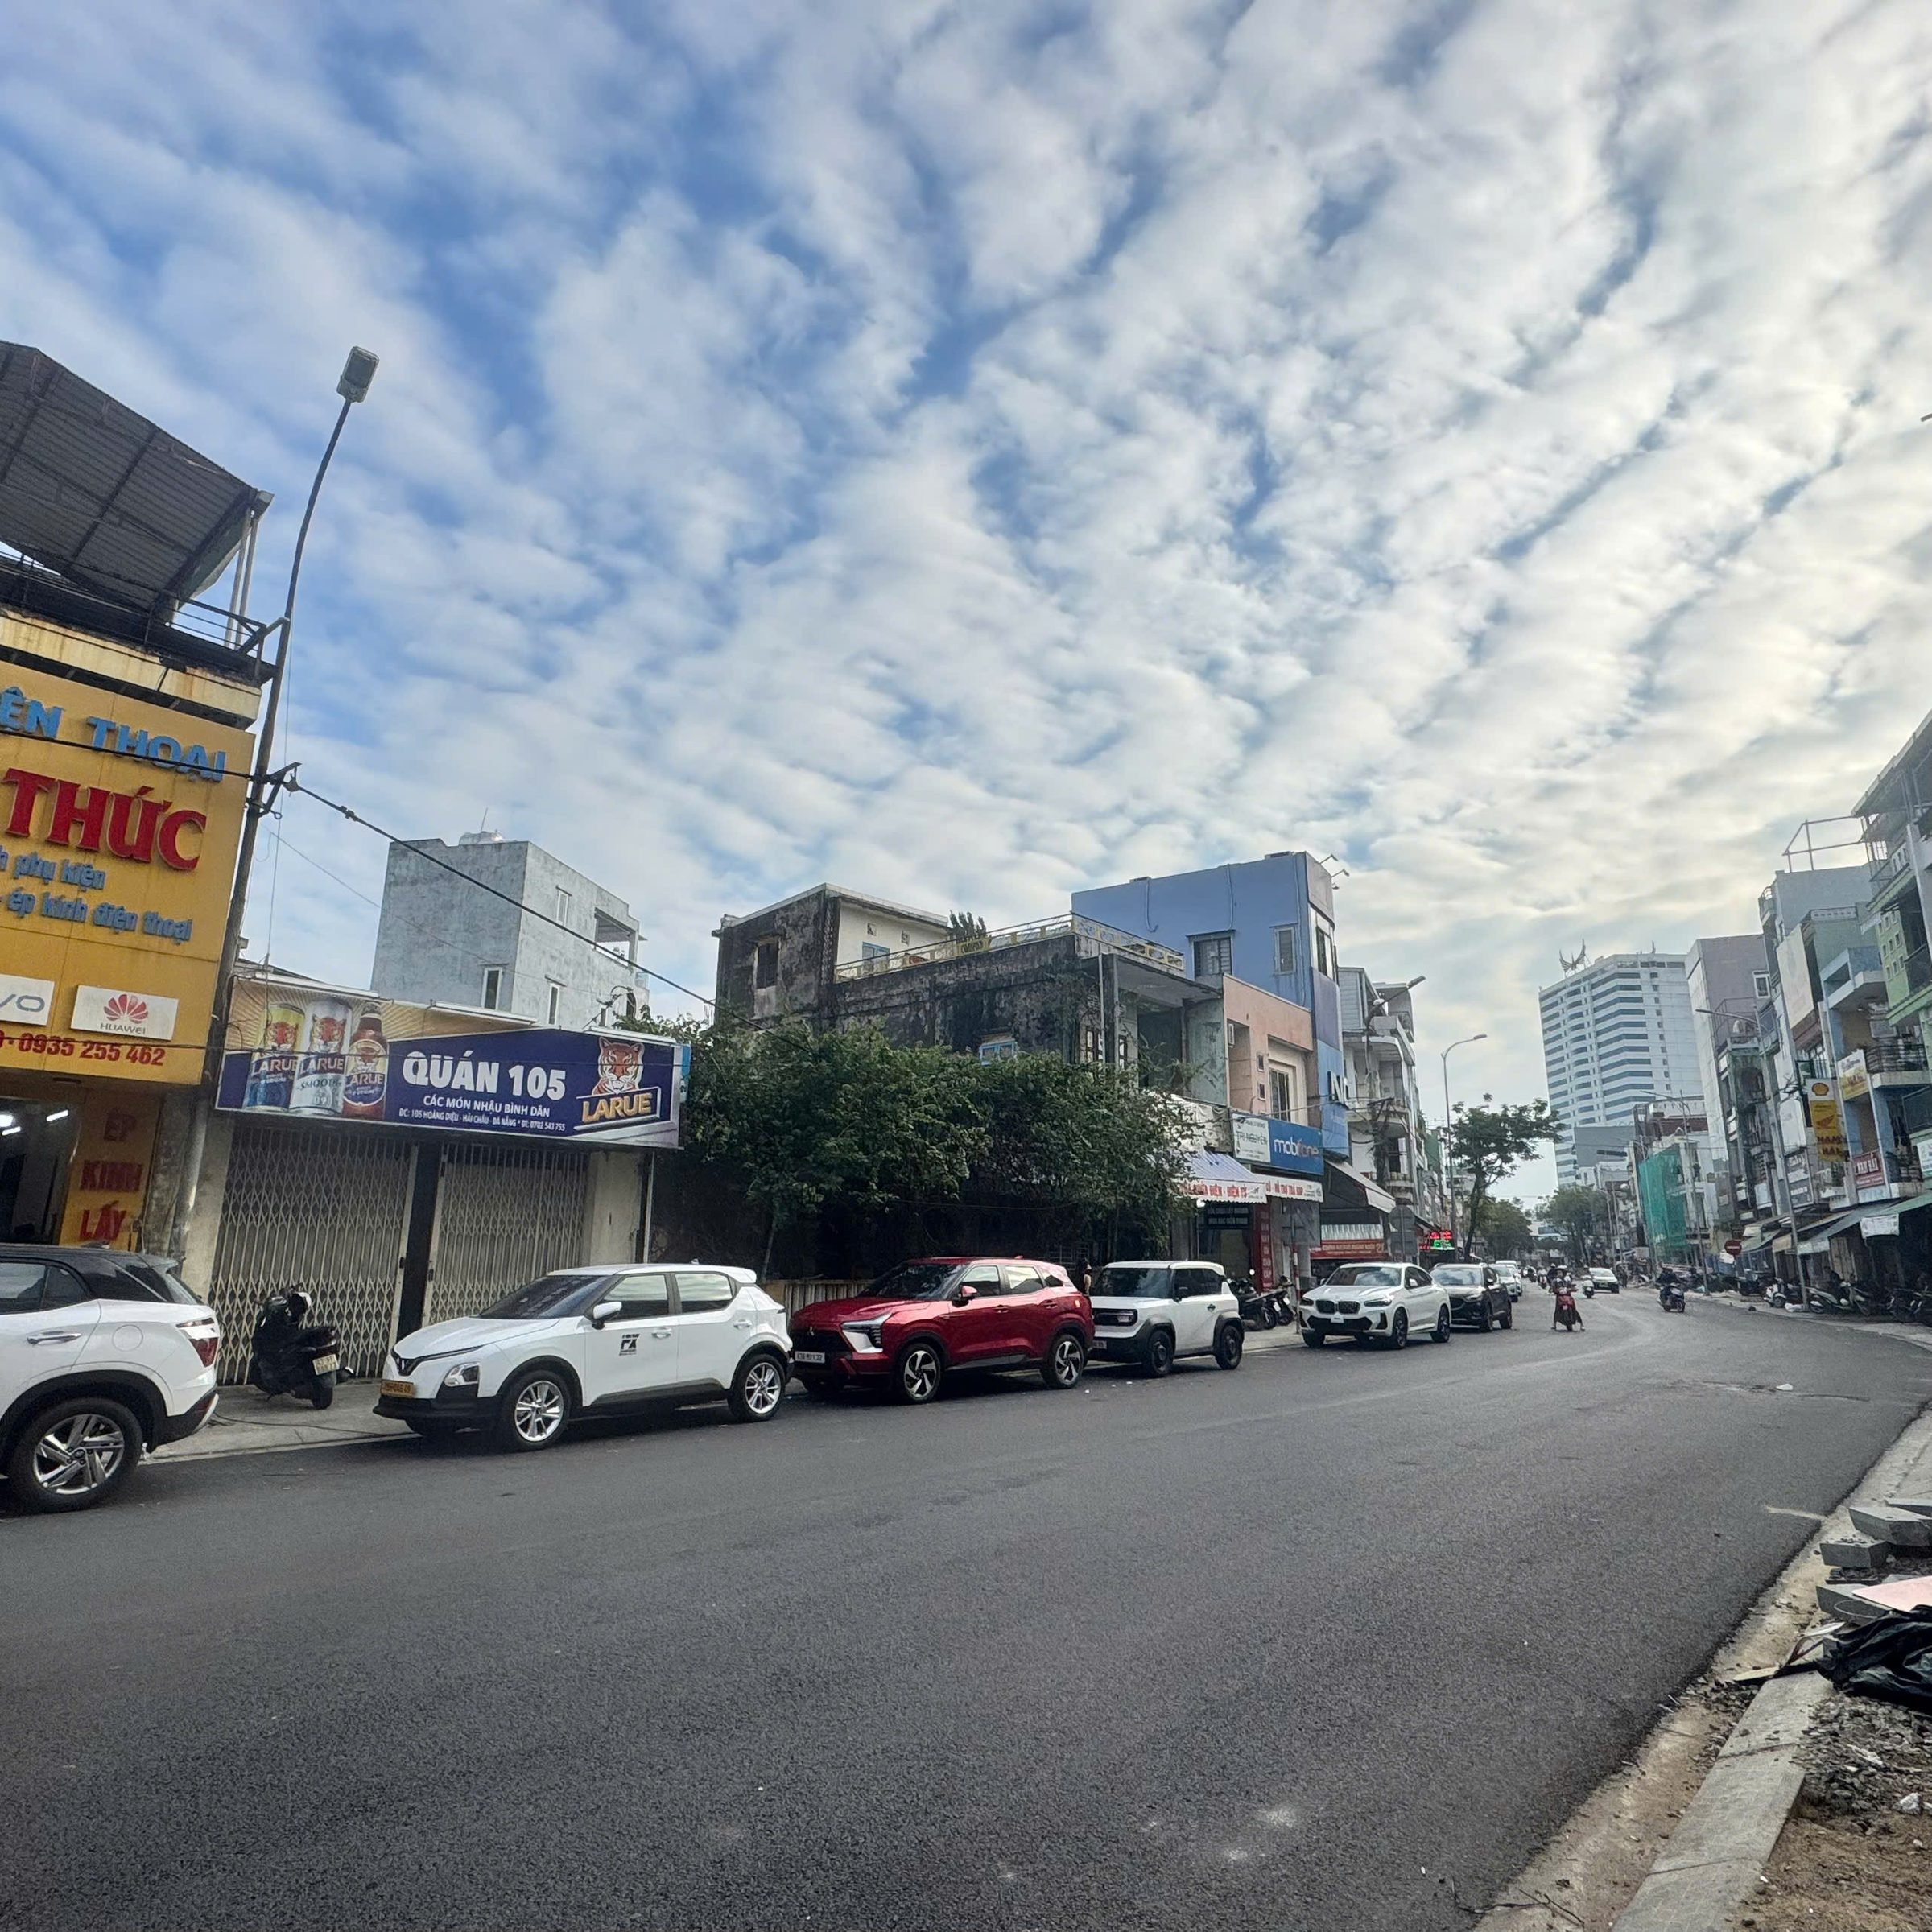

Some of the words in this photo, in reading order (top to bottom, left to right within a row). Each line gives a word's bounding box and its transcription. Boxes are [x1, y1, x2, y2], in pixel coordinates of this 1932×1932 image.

[2, 768, 207, 871] THỨC
[14, 852, 56, 885] phụ
[60, 859, 105, 892] kiện
[7, 887, 35, 918] ép
[41, 891, 88, 923] kính
[93, 902, 138, 934] điện
[143, 911, 193, 946] thoại
[100, 1022, 146, 1035] HUAWEI
[18, 1032, 76, 1056] 0935
[79, 1039, 121, 1062] 255
[126, 1046, 166, 1067] 462
[299, 1057, 345, 1075] LARUE
[402, 1050, 499, 1094] QUÁN
[509, 1064, 566, 1100] 105
[411, 1109, 423, 1118] 105
[423, 1094, 444, 1107] CÁC
[446, 1097, 471, 1109] MÓN
[473, 1100, 502, 1115] NHẬU
[504, 1102, 528, 1115] BÌNH
[530, 1105, 551, 1117] DÂN
[581, 1092, 653, 1124] LARUE
[1274, 1136, 1319, 1157] mobifone
